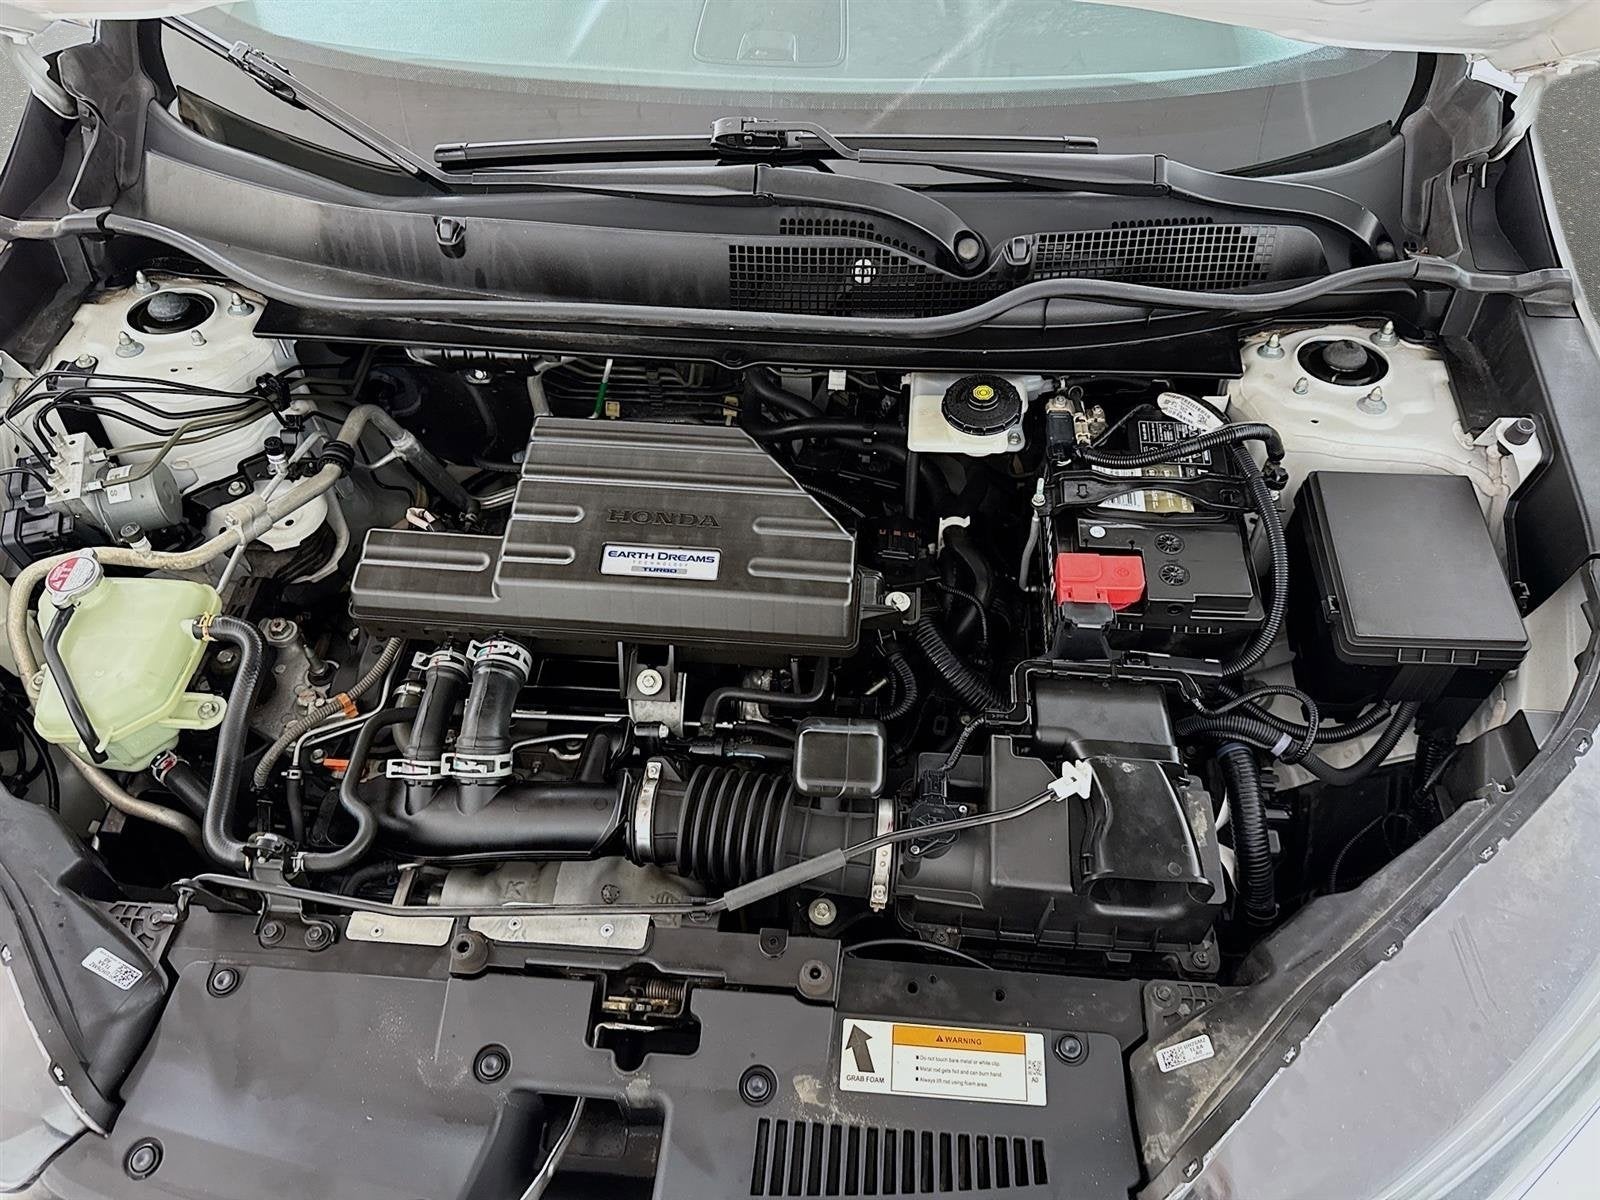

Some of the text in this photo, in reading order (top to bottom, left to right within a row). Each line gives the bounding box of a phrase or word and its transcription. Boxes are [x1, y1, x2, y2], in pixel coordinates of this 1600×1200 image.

[606, 509, 721, 528] HONDA
[608, 550, 715, 564] EARTH DREAMS
[642, 566, 677, 574] TURBO
[945, 1036, 982, 1046] WARNING
[846, 1074, 885, 1084] GRAB FOAM
